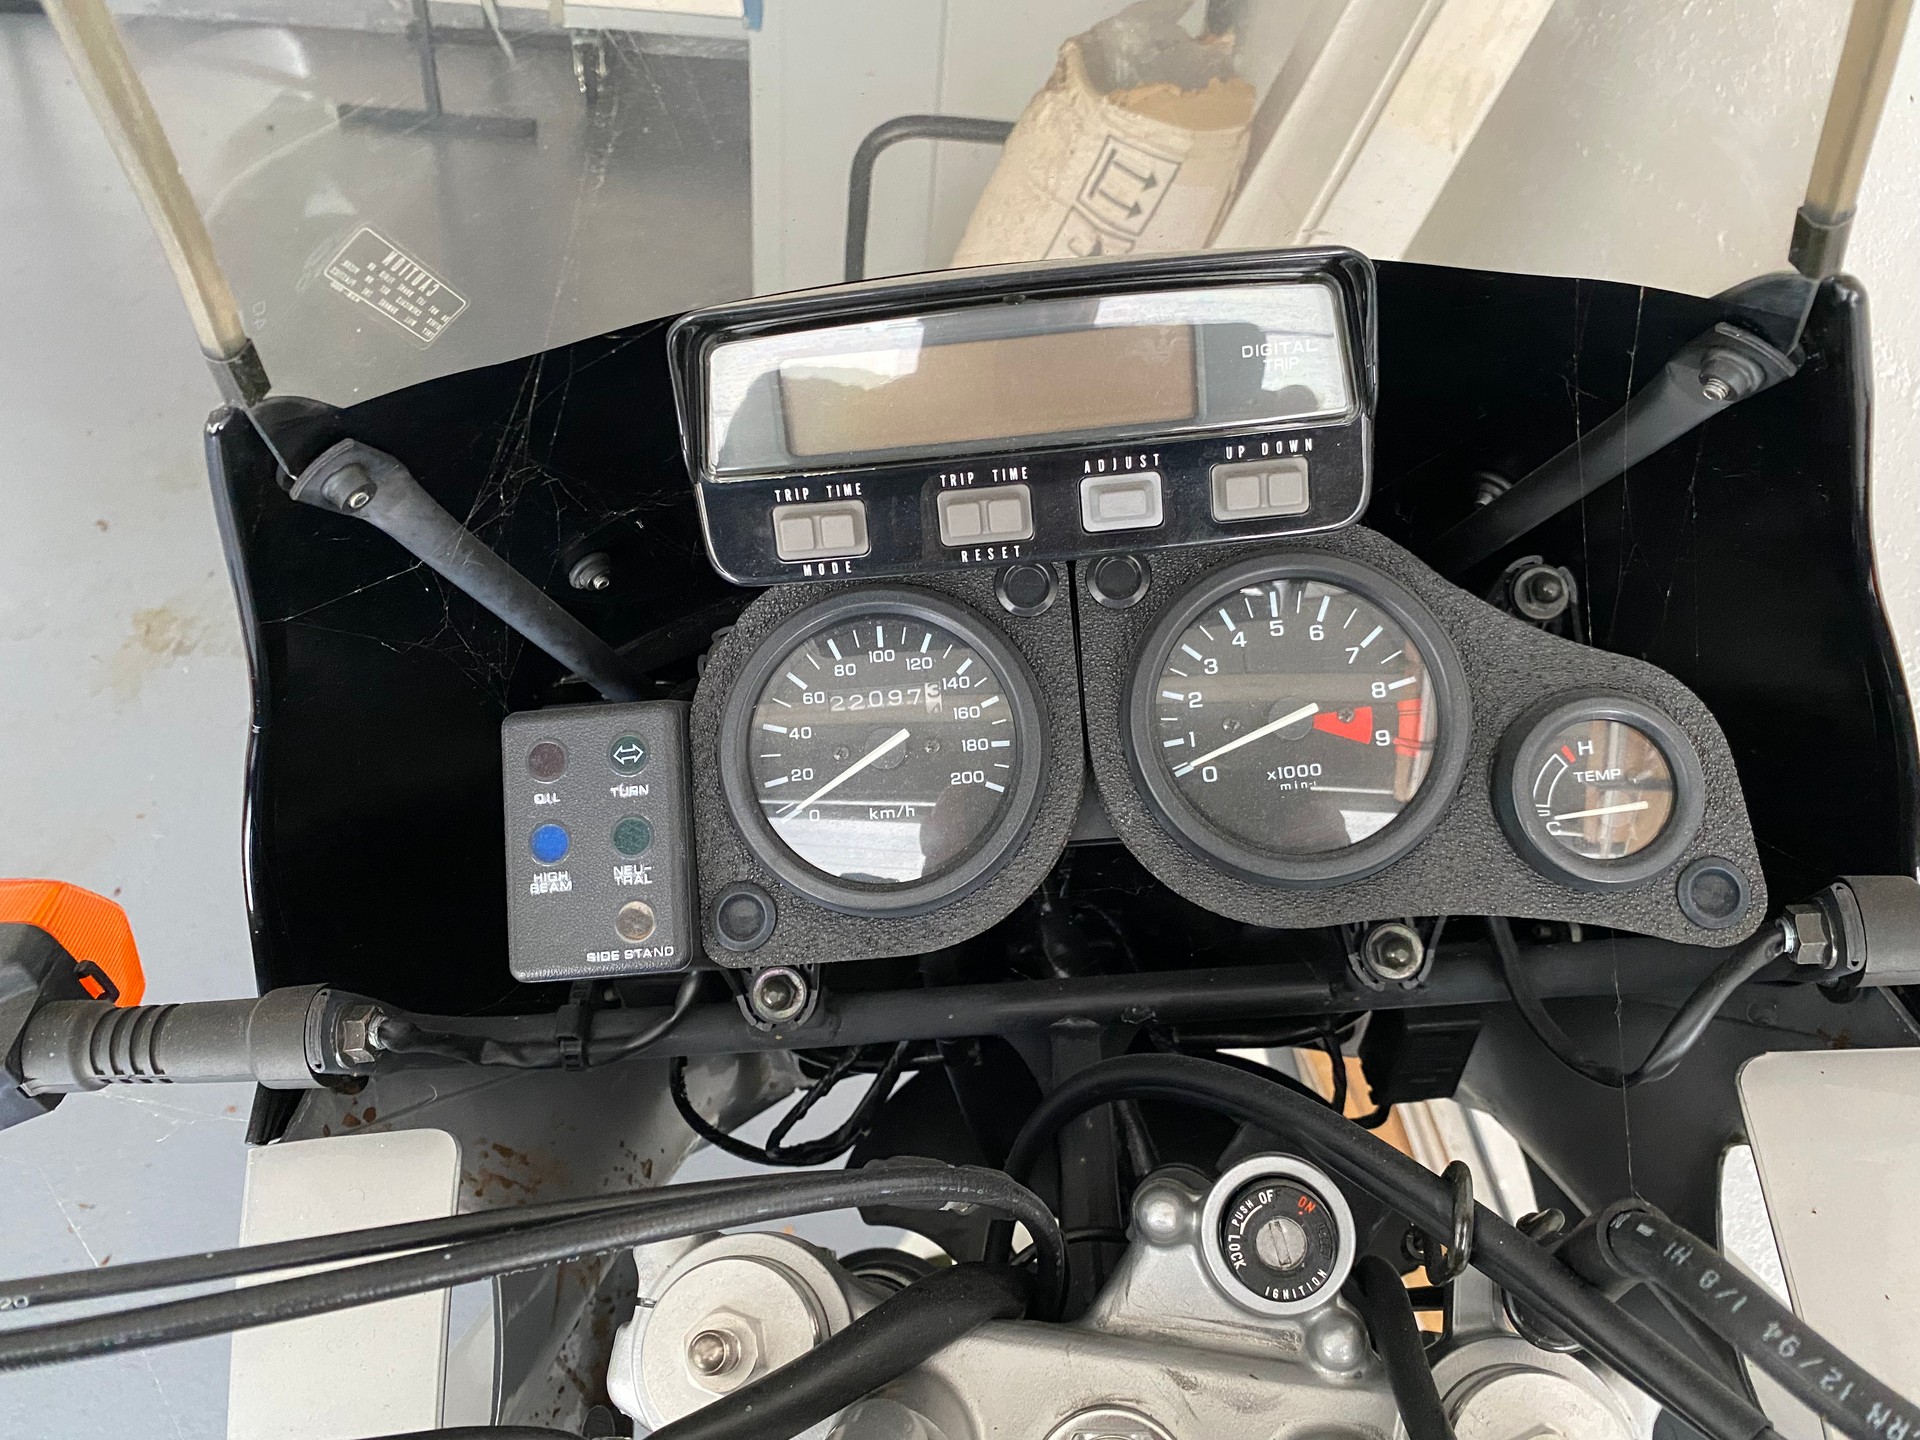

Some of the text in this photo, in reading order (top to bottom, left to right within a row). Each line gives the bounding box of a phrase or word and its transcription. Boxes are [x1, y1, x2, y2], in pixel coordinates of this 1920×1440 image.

[1241, 339, 1319, 359] DIGITAL
[1262, 356, 1300, 372] TRIP
[1225, 438, 1313, 460] UP DOWN
[1084, 453, 1161, 474] ADJUST
[940, 466, 1028, 488] TRIP TIME
[774, 482, 863, 503] TRIP TIME
[960, 545, 1021, 563] RESET
[802, 561, 852, 577] MODE
[1269, 620, 1284, 637] 5
[1309, 624, 1324, 641] 6
[1231, 631, 1247, 648] 4
[868, 649, 896, 663] 100
[905, 656, 933, 671] 120
[1345, 647, 1359, 664] 7
[834, 663, 857, 677] 80
[1203, 658, 1219, 675] 3
[942, 675, 971, 691] 140
[1371, 681, 1387, 698] 8
[802, 691, 826, 705] 60
[1187, 692, 1203, 708] 2
[953, 705, 981, 720] 160
[789, 726, 812, 740] 40
[1188, 731, 1196, 748] 1
[1374, 730, 1391, 747] 9
[961, 738, 989, 752] 180
[1577, 740, 1594, 756] H
[791, 767, 814, 782] 20
[950, 770, 985, 785] 200
[1202, 765, 1218, 783] 0
[1573, 768, 1622, 783] TEMP
[533, 793, 561, 804] OIL
[610, 784, 649, 798] TURN
[808, 809, 820, 822] 0
[869, 804, 916, 820] km/h
[1546, 821, 1562, 836] C
[533, 871, 569, 883] HIGH
[613, 865, 652, 878] NEU-
[530, 880, 573, 895] BEAM
[614, 874, 652, 887] TRAL
[586, 946, 675, 963] SIDE STAND
[1297, 1195, 1317, 1214] ON
[1231, 1199, 1254, 1227] PUSH
[1228, 1234, 1247, 1270] LOCK
[1265, 1268, 1328, 1300] IGNITION
